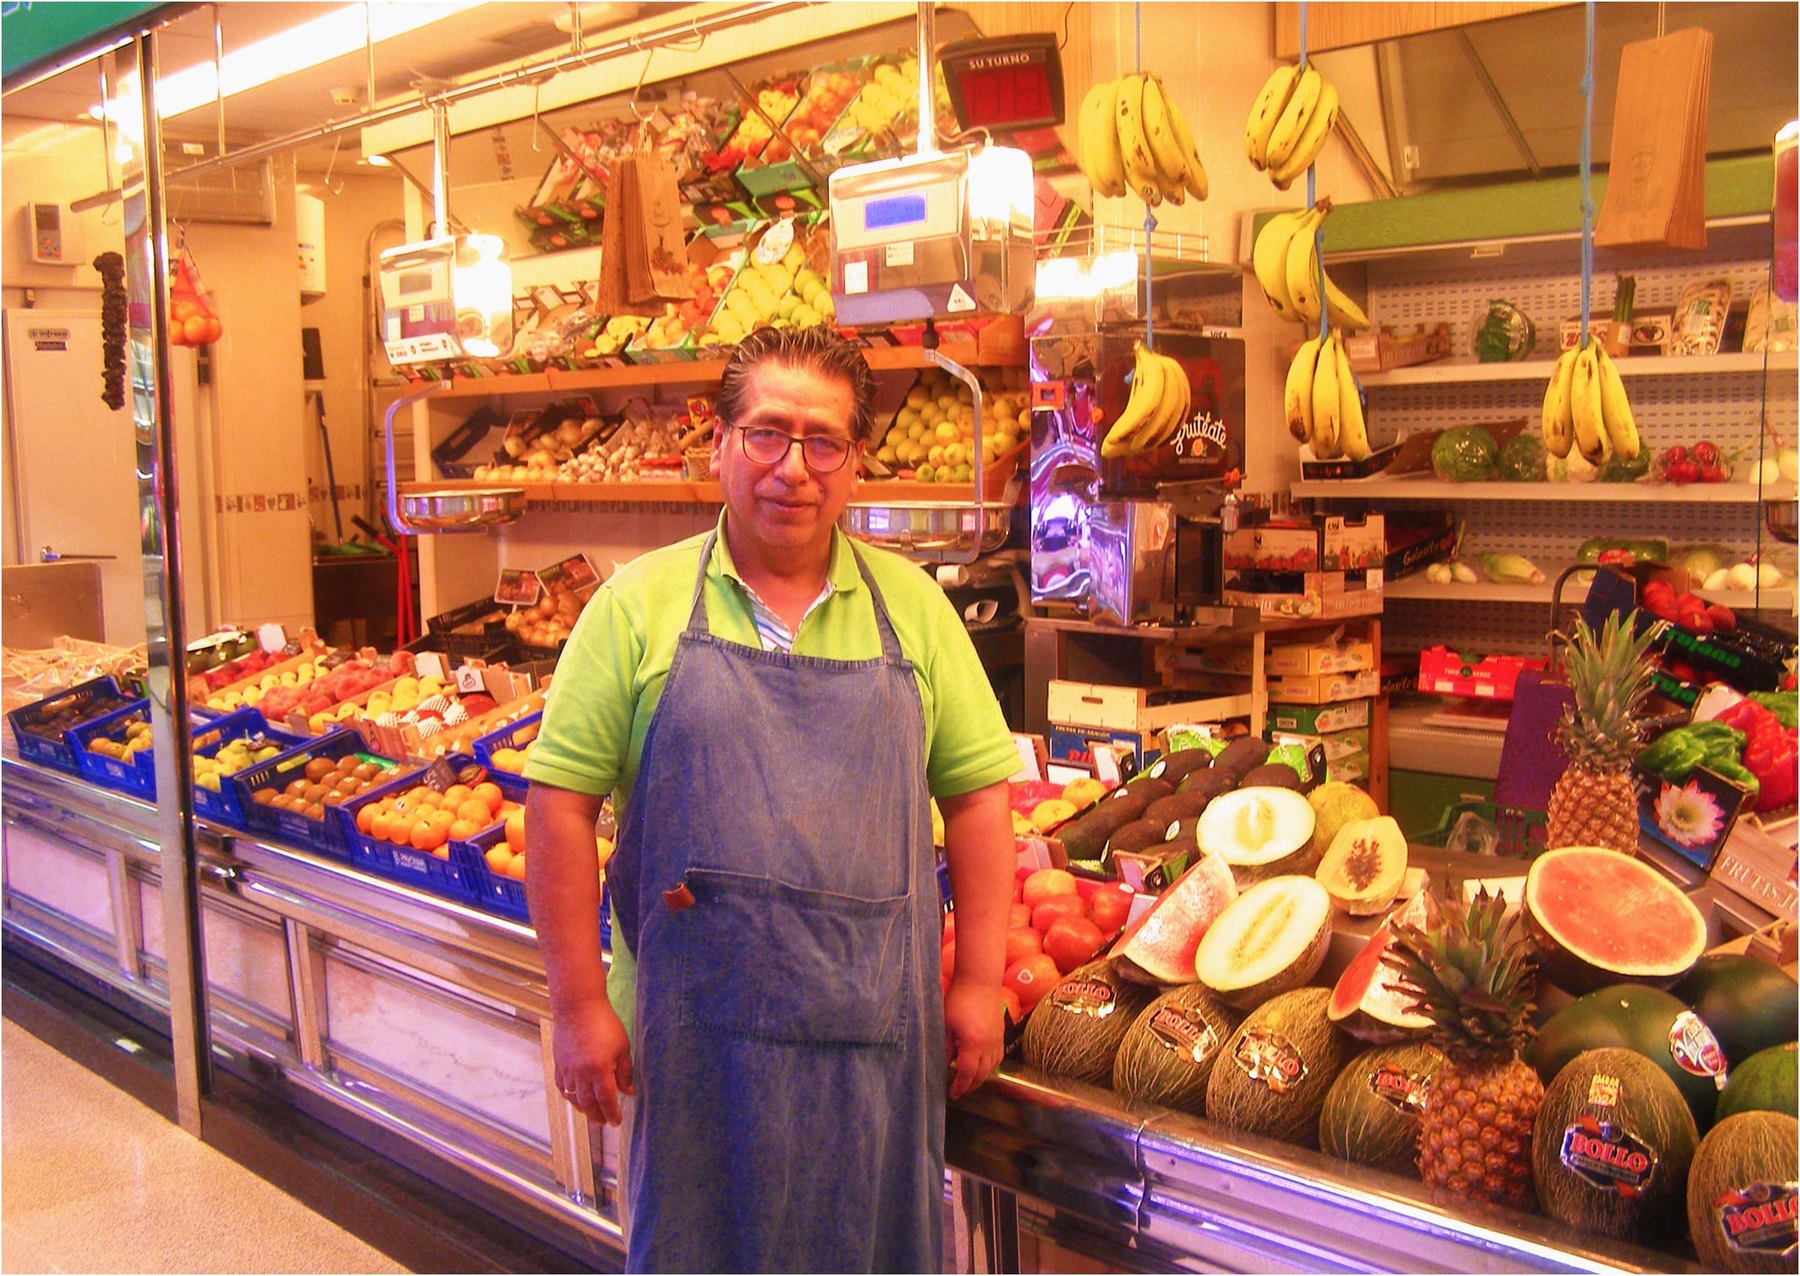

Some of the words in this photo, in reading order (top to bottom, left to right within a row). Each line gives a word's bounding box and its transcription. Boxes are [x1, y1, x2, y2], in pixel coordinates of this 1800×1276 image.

[969, 60, 984, 70] SU
[988, 53, 1030, 67] TURNO
[1055, 725, 1076, 734] FRUTAS
[1719, 855, 1779, 902] FRUTAS
[1587, 1093, 1617, 1107] 2024
[1569, 1131, 1648, 1173] BOLLO
